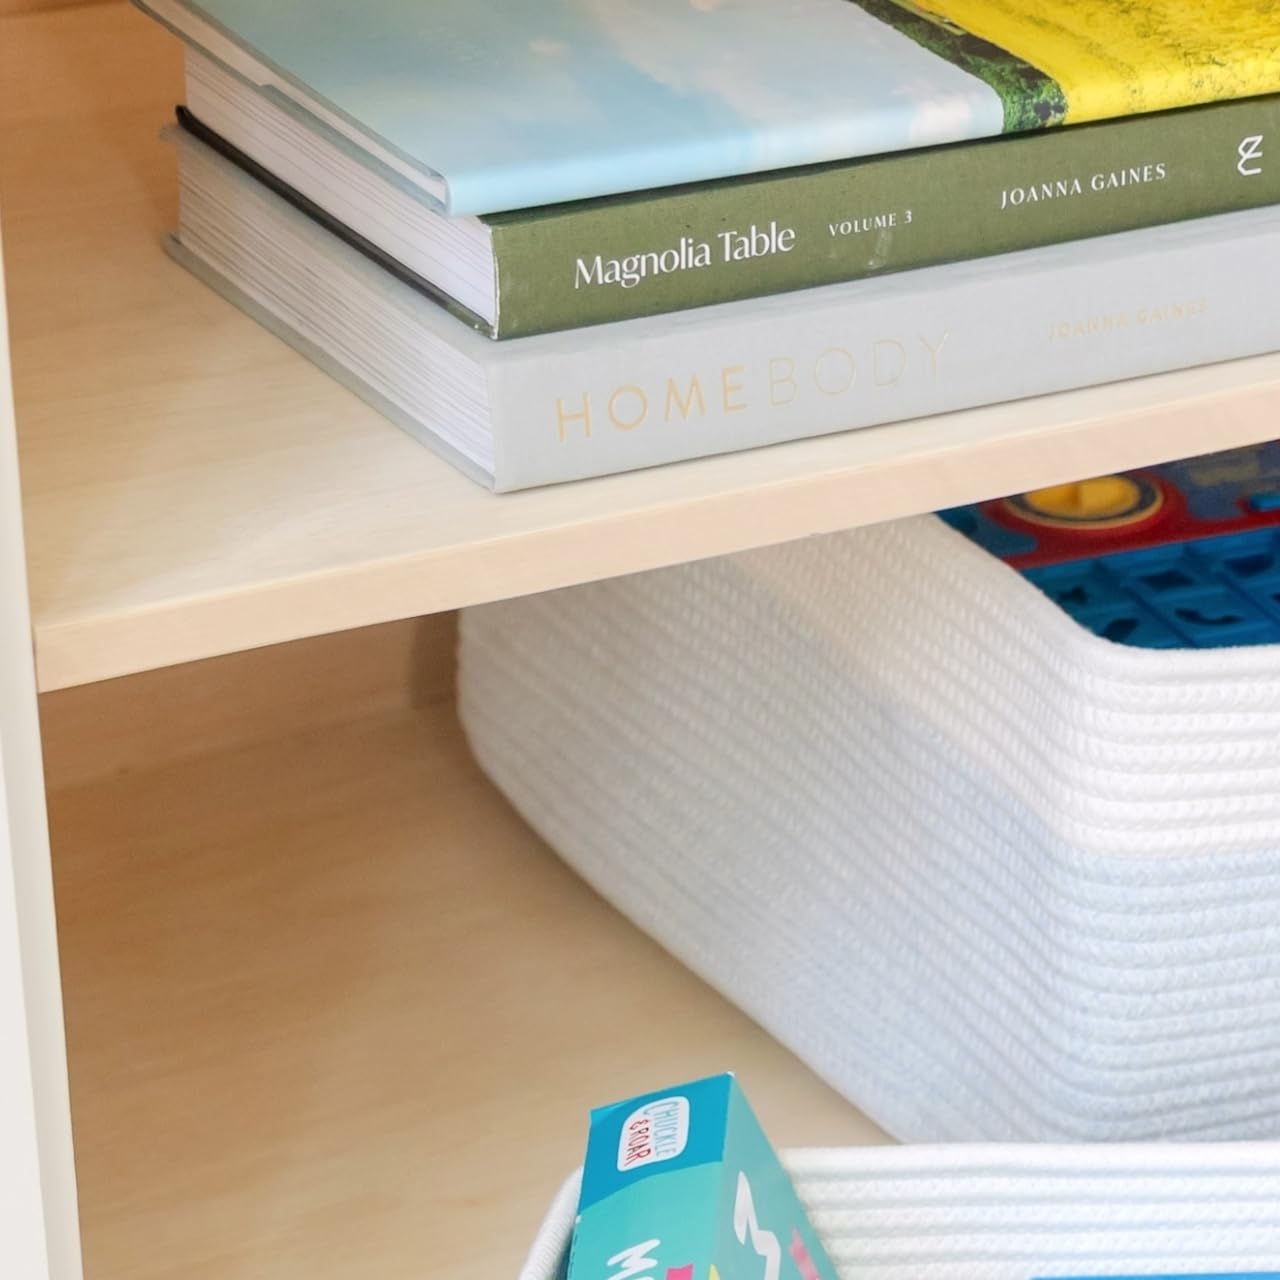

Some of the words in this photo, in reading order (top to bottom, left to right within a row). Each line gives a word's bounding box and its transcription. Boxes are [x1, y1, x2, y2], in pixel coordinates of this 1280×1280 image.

[1001, 178, 1082, 210] JOANNA
[1091, 163, 1166, 192] GAINES
[574, 237, 711, 289] Magnolia
[718, 221, 796, 262] Table
[828, 213, 897, 236] VOLUME
[904, 210, 913, 224] 3
[1048, 311, 1130, 343] JOANNA
[555, 326, 954, 442] HOMEBODY
[643, 1101, 679, 1157] CHUCKLE
